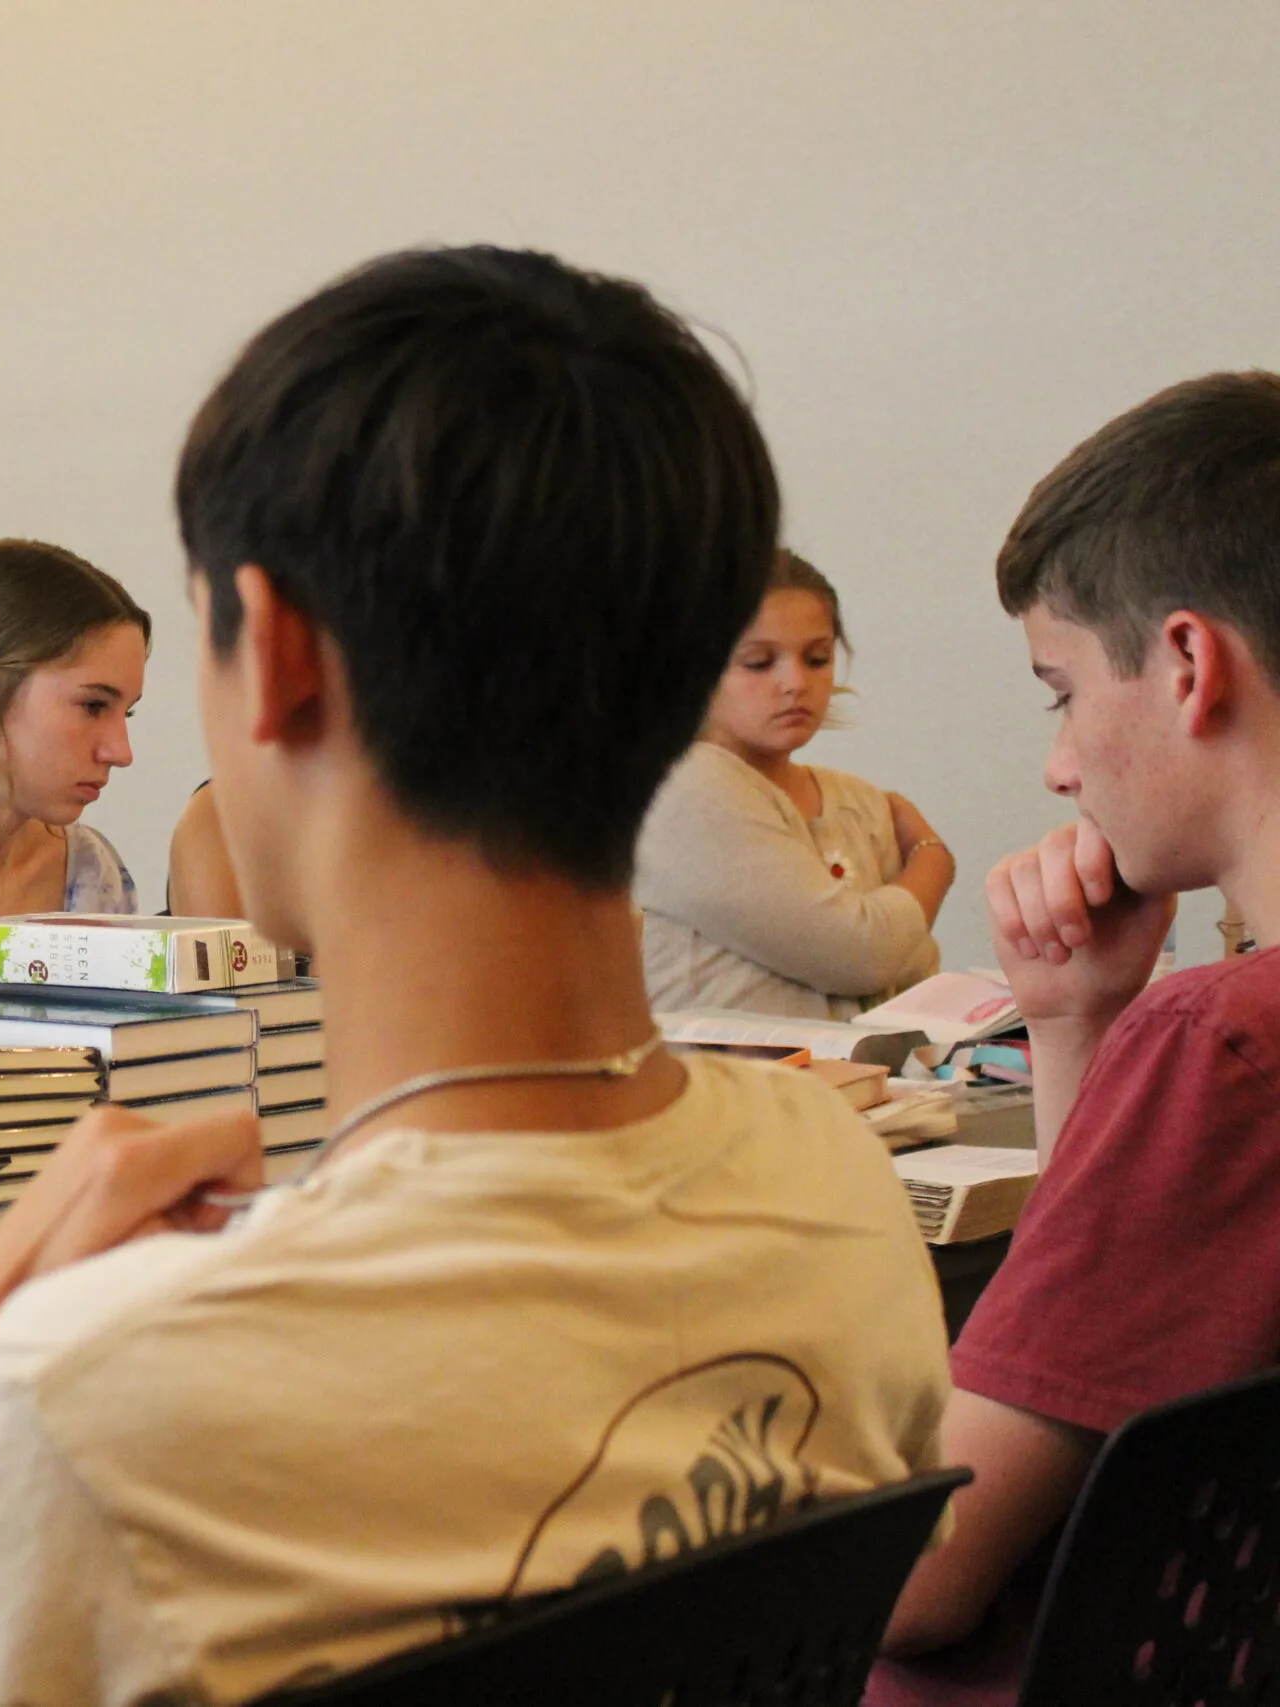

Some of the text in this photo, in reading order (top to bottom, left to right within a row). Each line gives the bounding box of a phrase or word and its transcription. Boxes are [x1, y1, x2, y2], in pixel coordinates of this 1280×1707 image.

[49, 934, 59, 980] BIBLE
[63, 934, 73, 982] STUDY
[78, 935, 89, 981] TEEN
